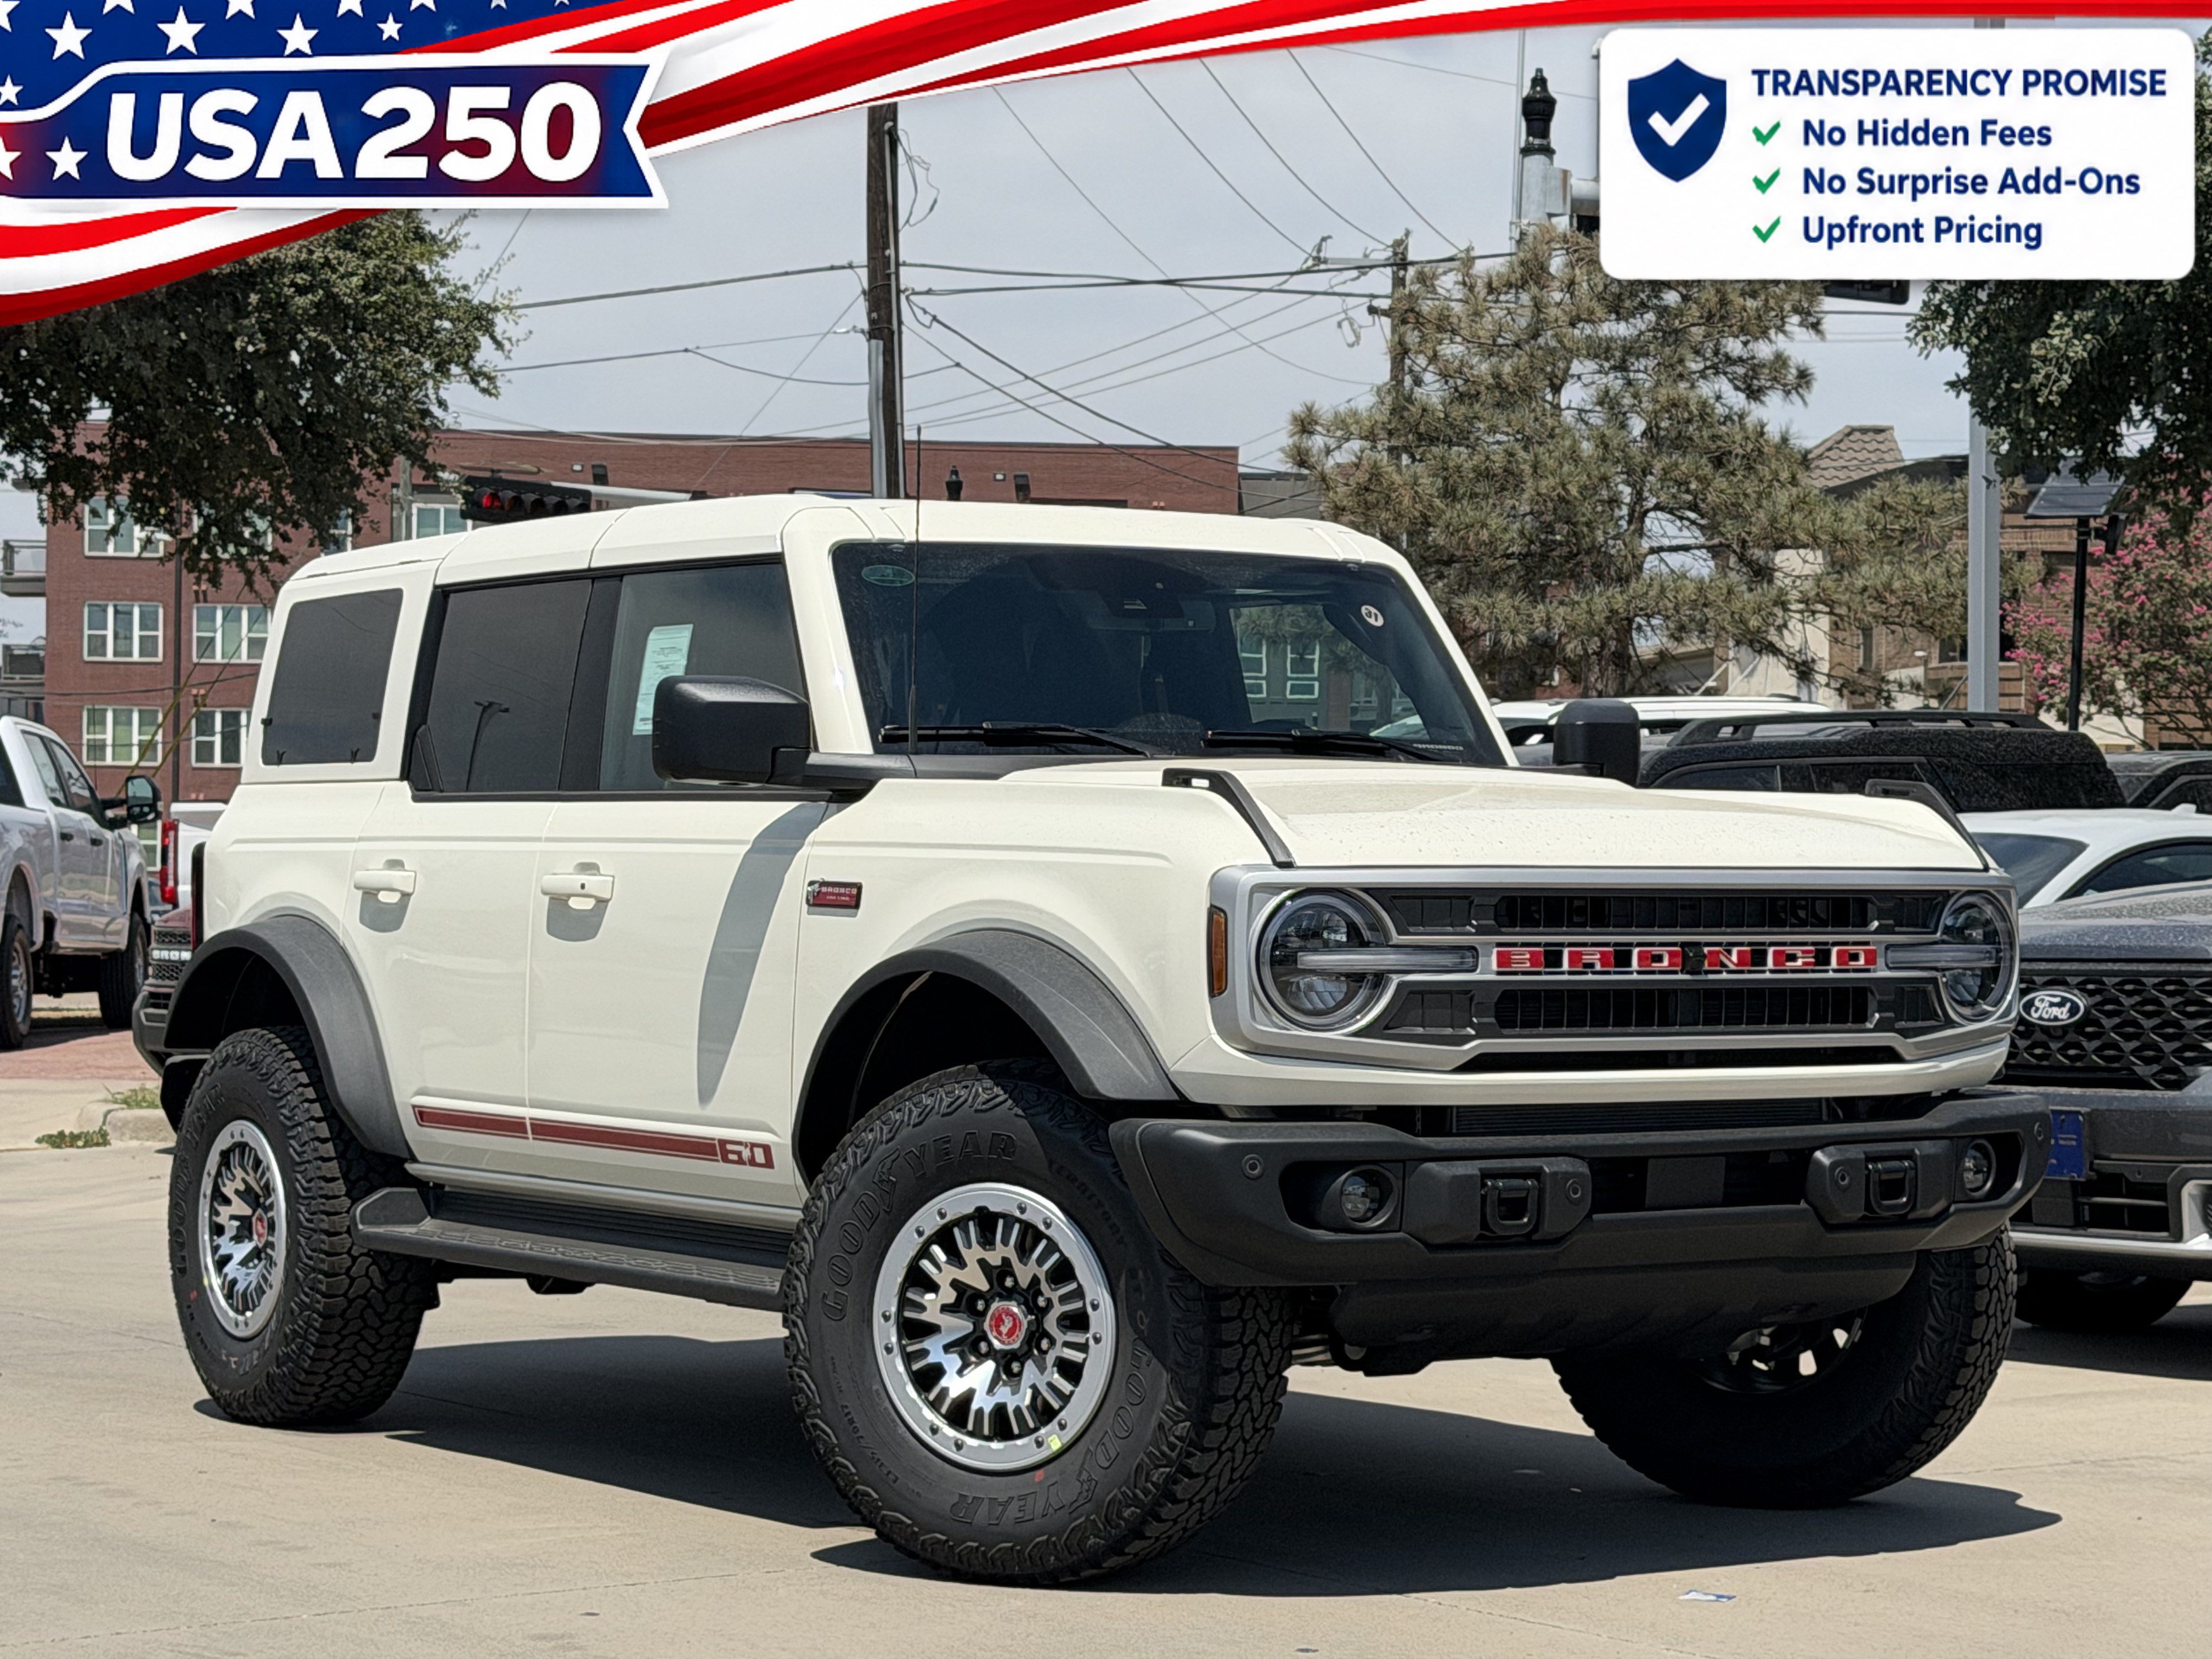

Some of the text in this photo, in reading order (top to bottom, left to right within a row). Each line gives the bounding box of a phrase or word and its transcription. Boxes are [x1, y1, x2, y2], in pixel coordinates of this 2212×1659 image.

[152, 949, 192, 961] BRON
[1492, 945, 1877, 972] BRONCO
[2030, 995, 2072, 1019] Ford
[717, 1138, 775, 1170] 60
[822, 1130, 1017, 1322] GOODYEAR
[949, 1335, 1153, 1526] GOODYEAR
